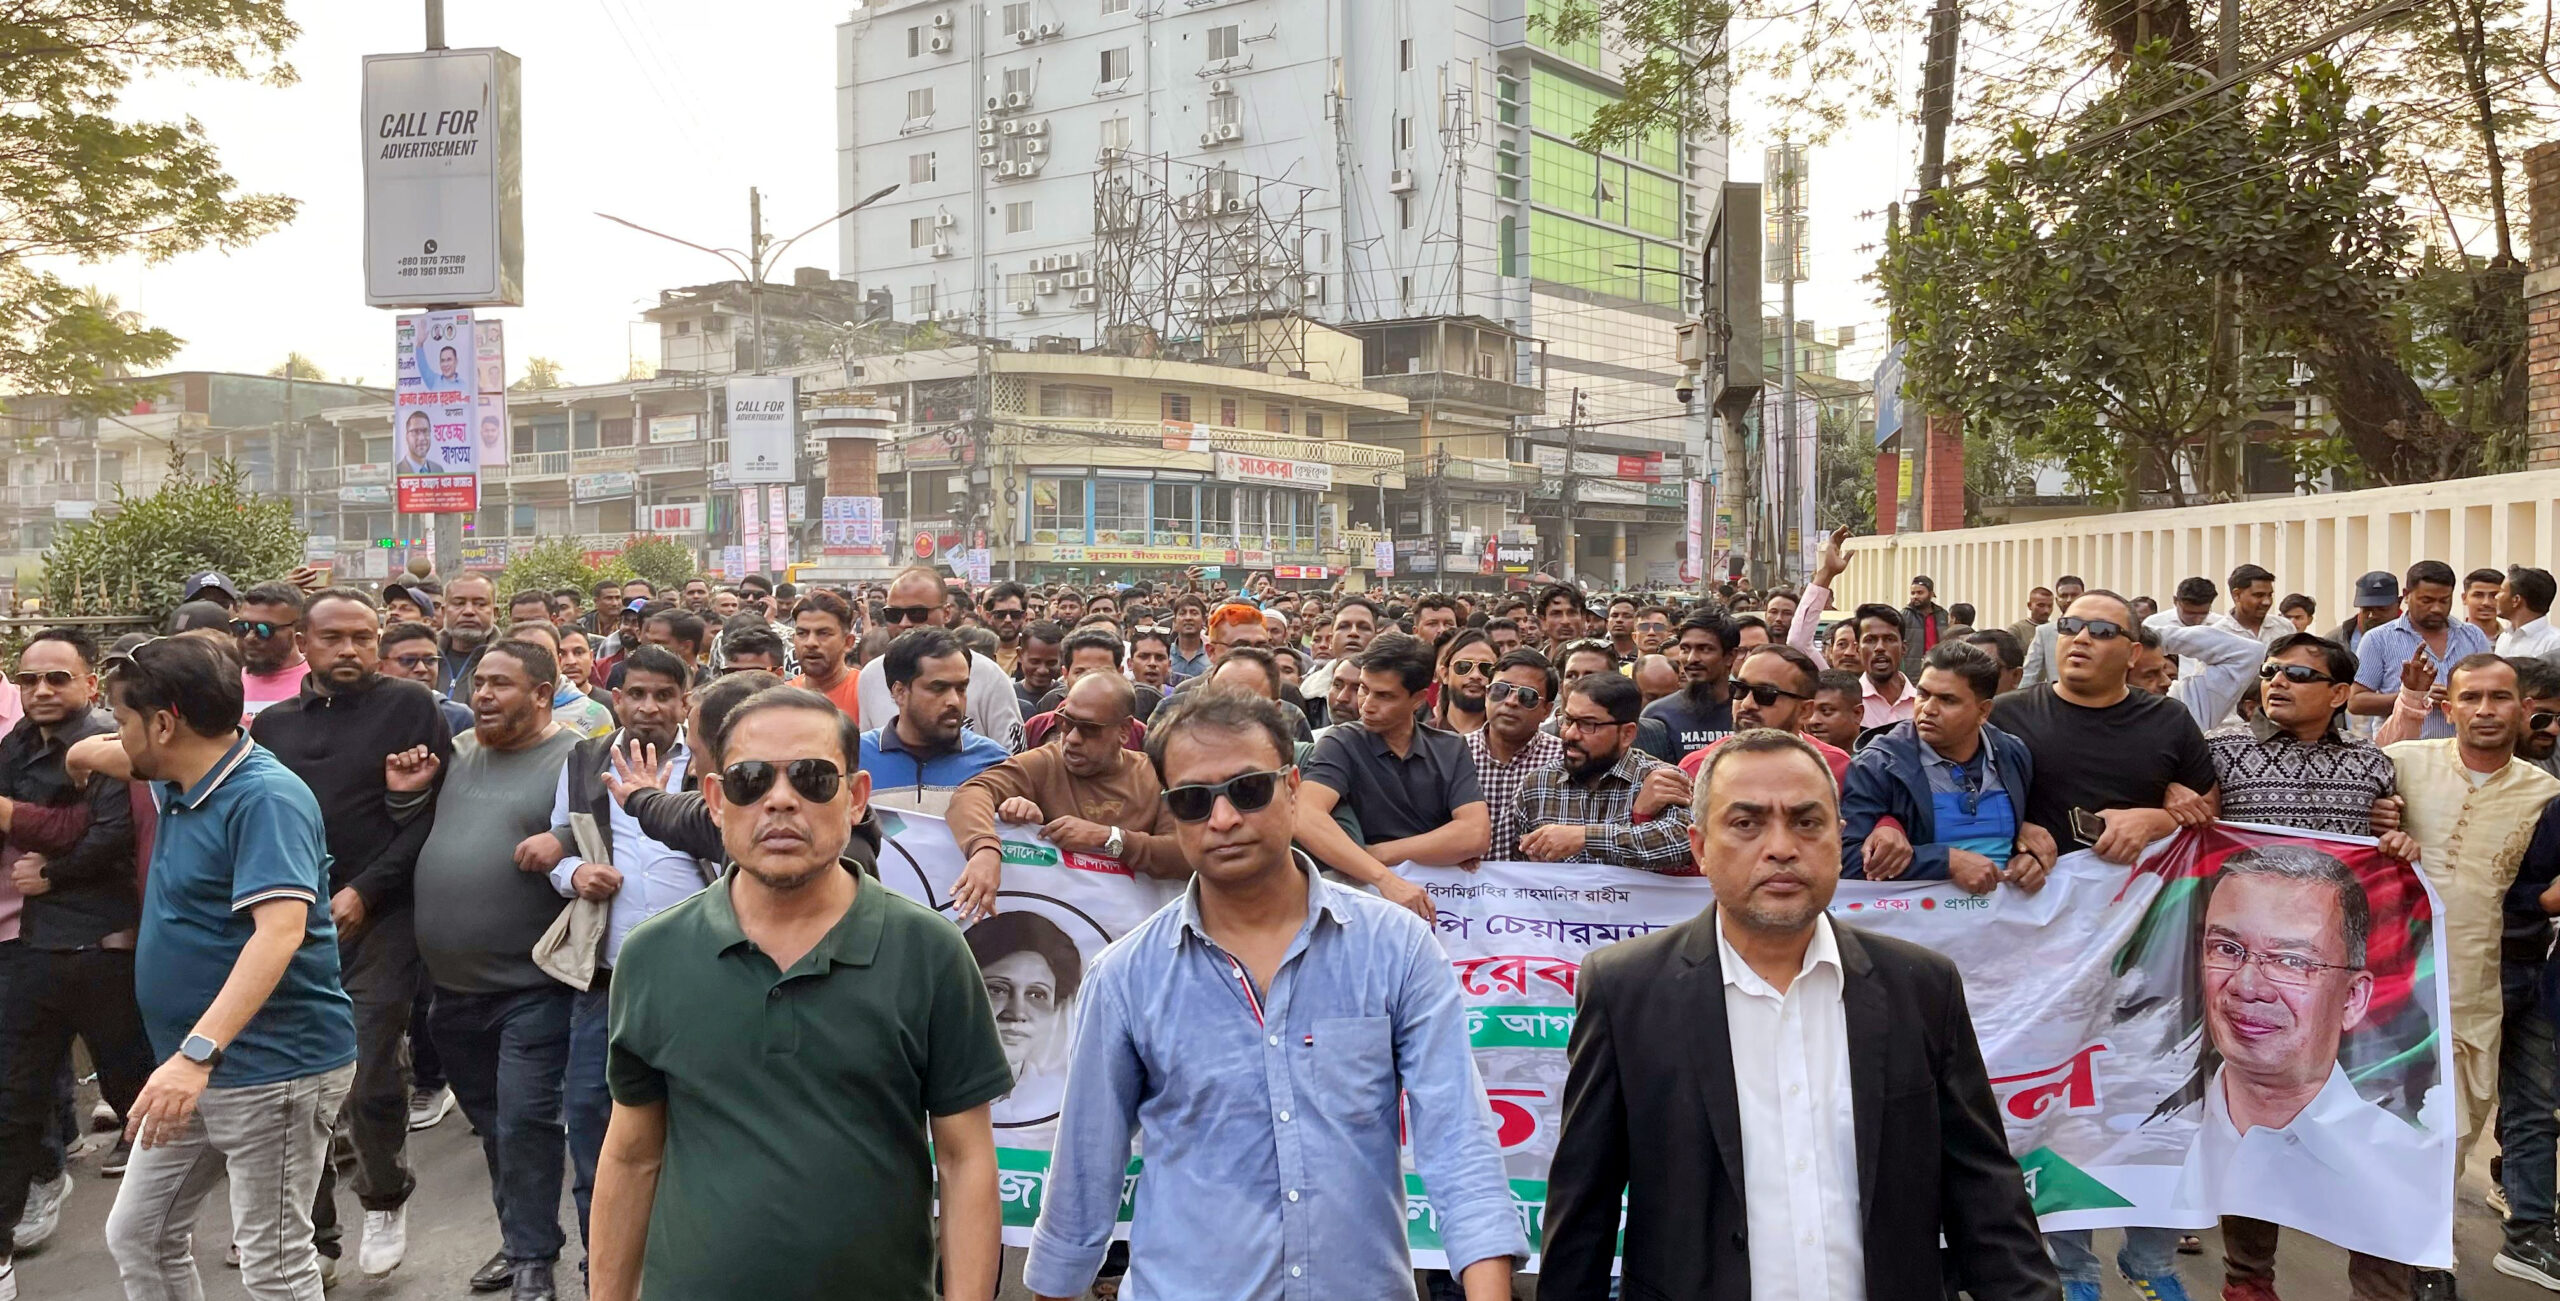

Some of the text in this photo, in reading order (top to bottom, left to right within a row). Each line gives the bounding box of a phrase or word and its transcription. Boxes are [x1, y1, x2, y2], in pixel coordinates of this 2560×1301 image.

[380, 110, 478, 138] CALL FOR
[380, 140, 478, 159] ADVERTISEMENT
[398, 257, 418, 266] +880
[398, 267, 418, 277] +880
[420, 267, 437, 276] 1961
[736, 401, 785, 412] CALL FOR
[736, 413, 784, 421] ADVERTISEMENT
[1238, 457, 1293, 478] সাতকরা
[1000, 844, 1046, 860] ংলাদেশ
[1424, 882, 1631, 904] বিসমিল্লাহির রাহমানির রাহীম
[1944, 894, 1990, 911] প্রগতি
